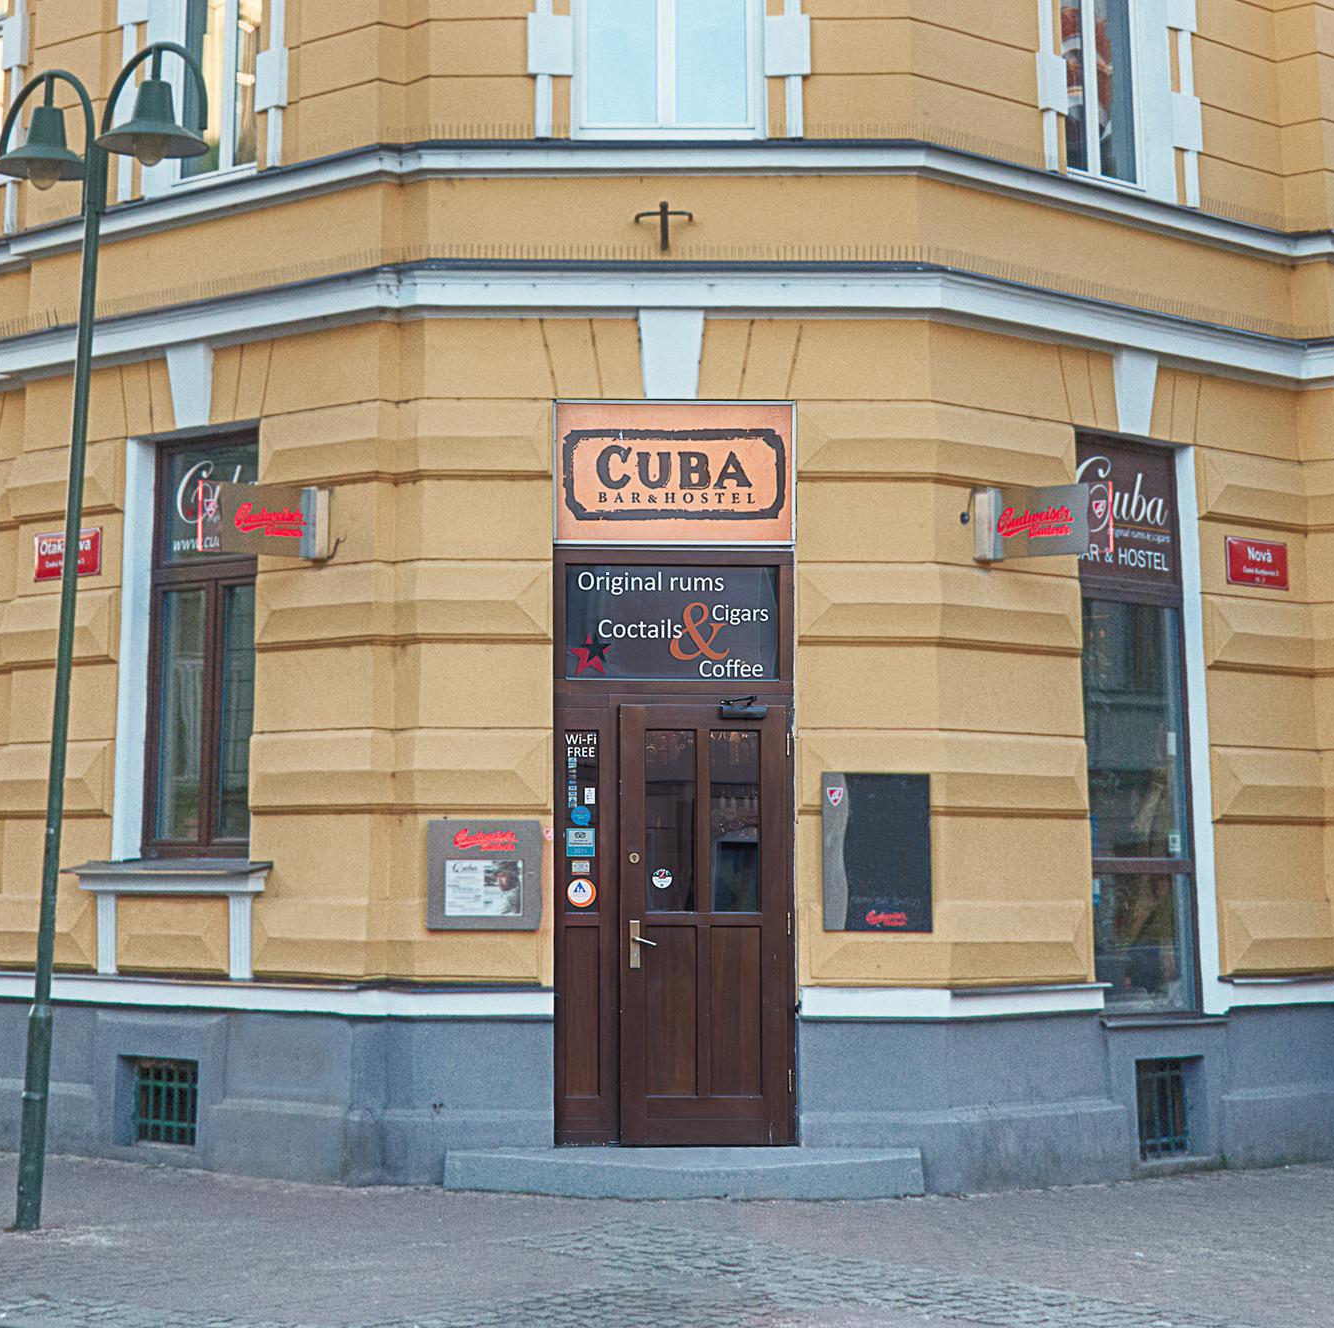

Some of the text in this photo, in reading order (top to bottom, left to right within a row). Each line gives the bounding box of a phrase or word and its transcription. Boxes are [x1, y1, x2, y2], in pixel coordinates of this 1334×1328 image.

[596, 445, 753, 490] CUBA
[1118, 547, 1170, 572] HOSTEL
[1247, 545, 1273, 563] Nová
[577, 571, 724, 595] Original rums
[712, 604, 769, 625] Cigars
[598, 618, 683, 639] Coctails
[669, 601, 730, 661] &
[699, 659, 764, 678] Coffee
[565, 733, 597, 745] Wi-Fi
[567, 747, 595, 757] FREE
